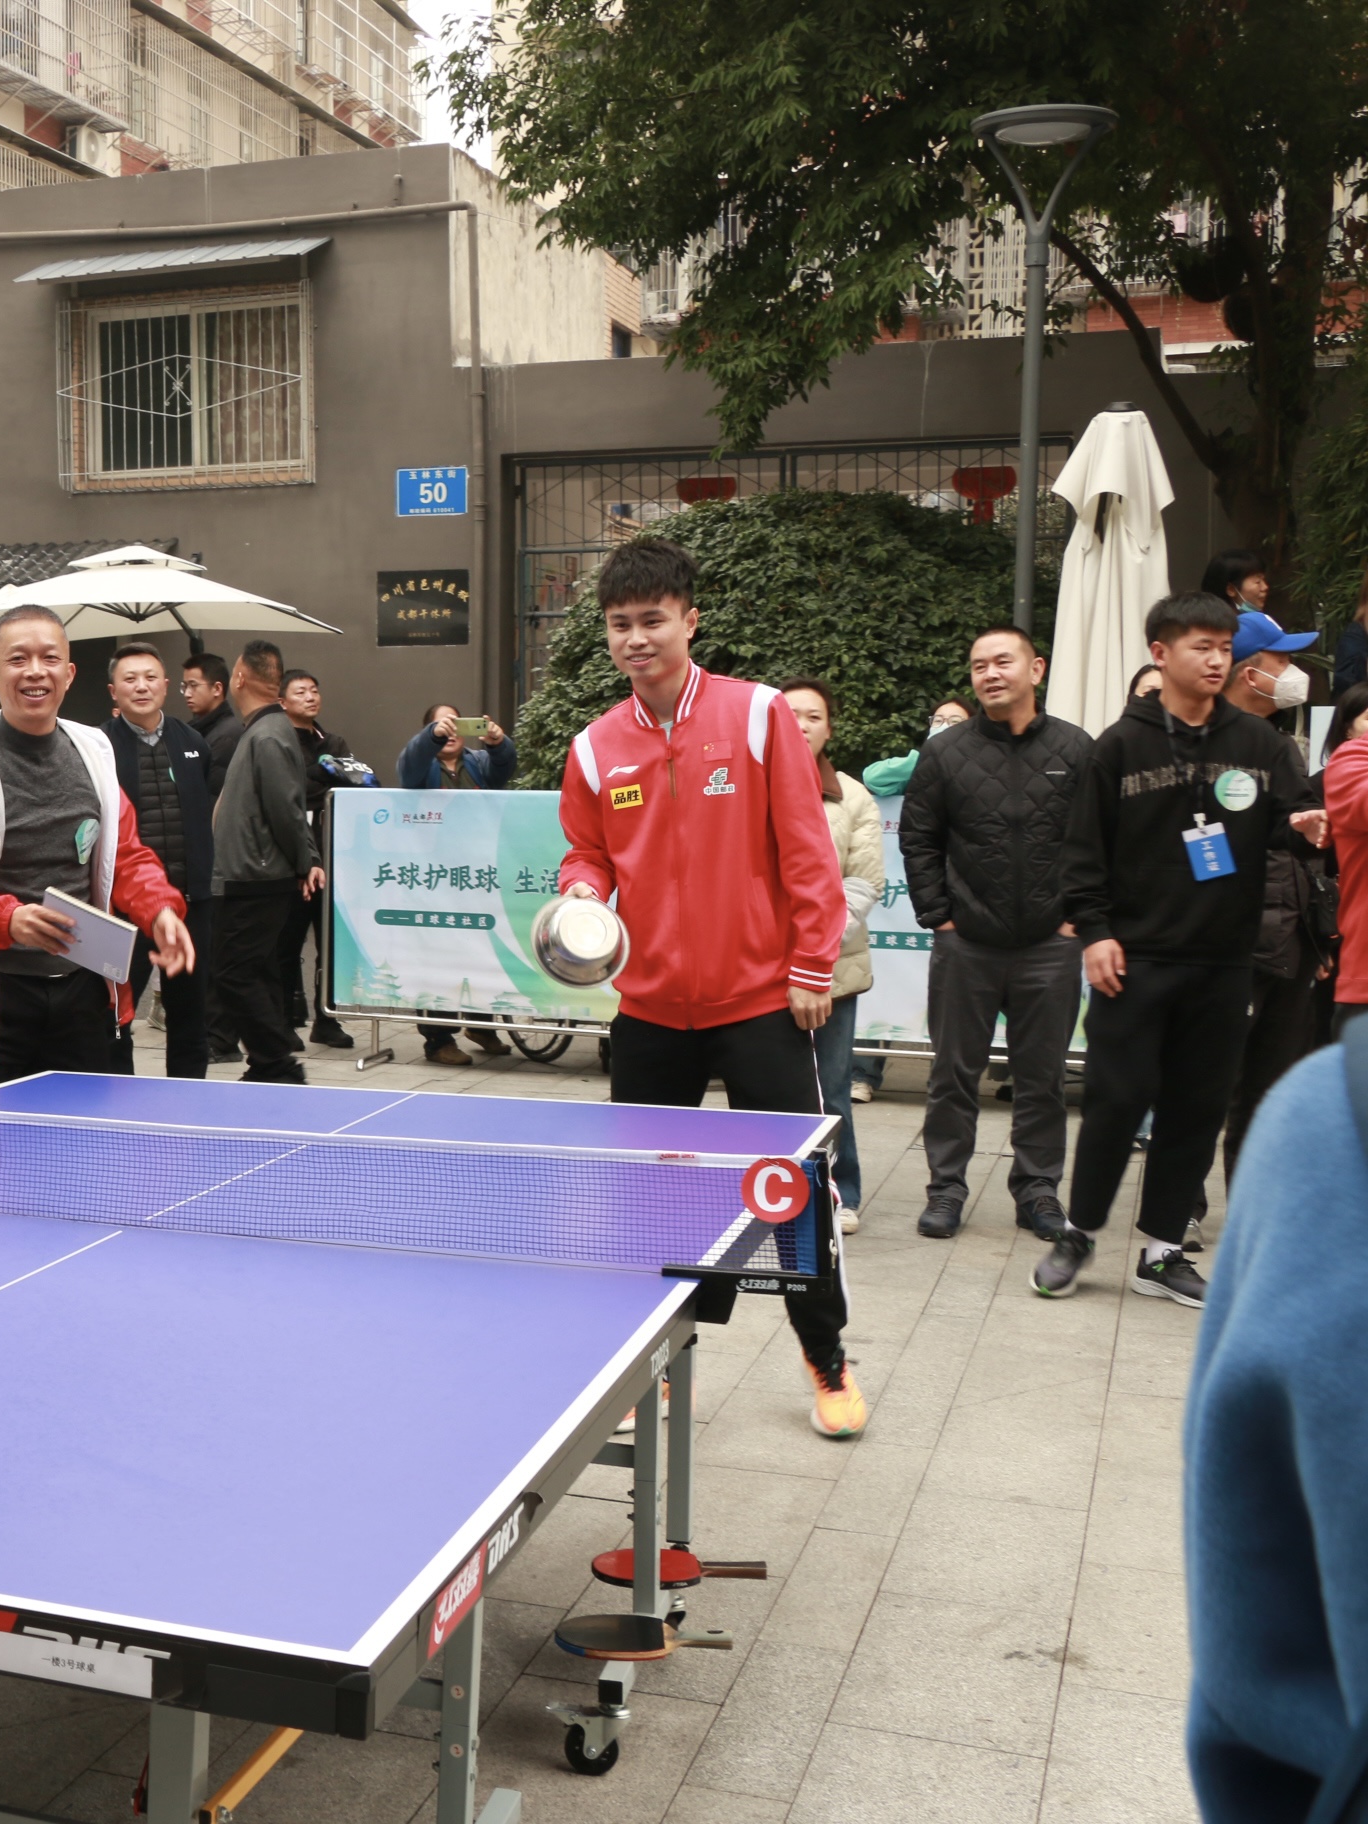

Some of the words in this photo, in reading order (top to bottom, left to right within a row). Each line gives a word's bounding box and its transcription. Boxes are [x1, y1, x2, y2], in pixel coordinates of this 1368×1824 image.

[409, 470, 456, 479] 玉林东街
[419, 482, 447, 503] 50
[614, 790, 640, 805] 品胜
[373, 862, 501, 893] 乒球护眼球
[514, 866, 561, 895] 生活
[753, 1165, 793, 1212] C
[736, 1279, 780, 1291] 红双喜
[787, 1284, 807, 1292] P205
[487, 1502, 524, 1574] DHS
[434, 1551, 480, 1644] 红双喜
[41, 1656, 96, 1674] 一楼3号球桌
